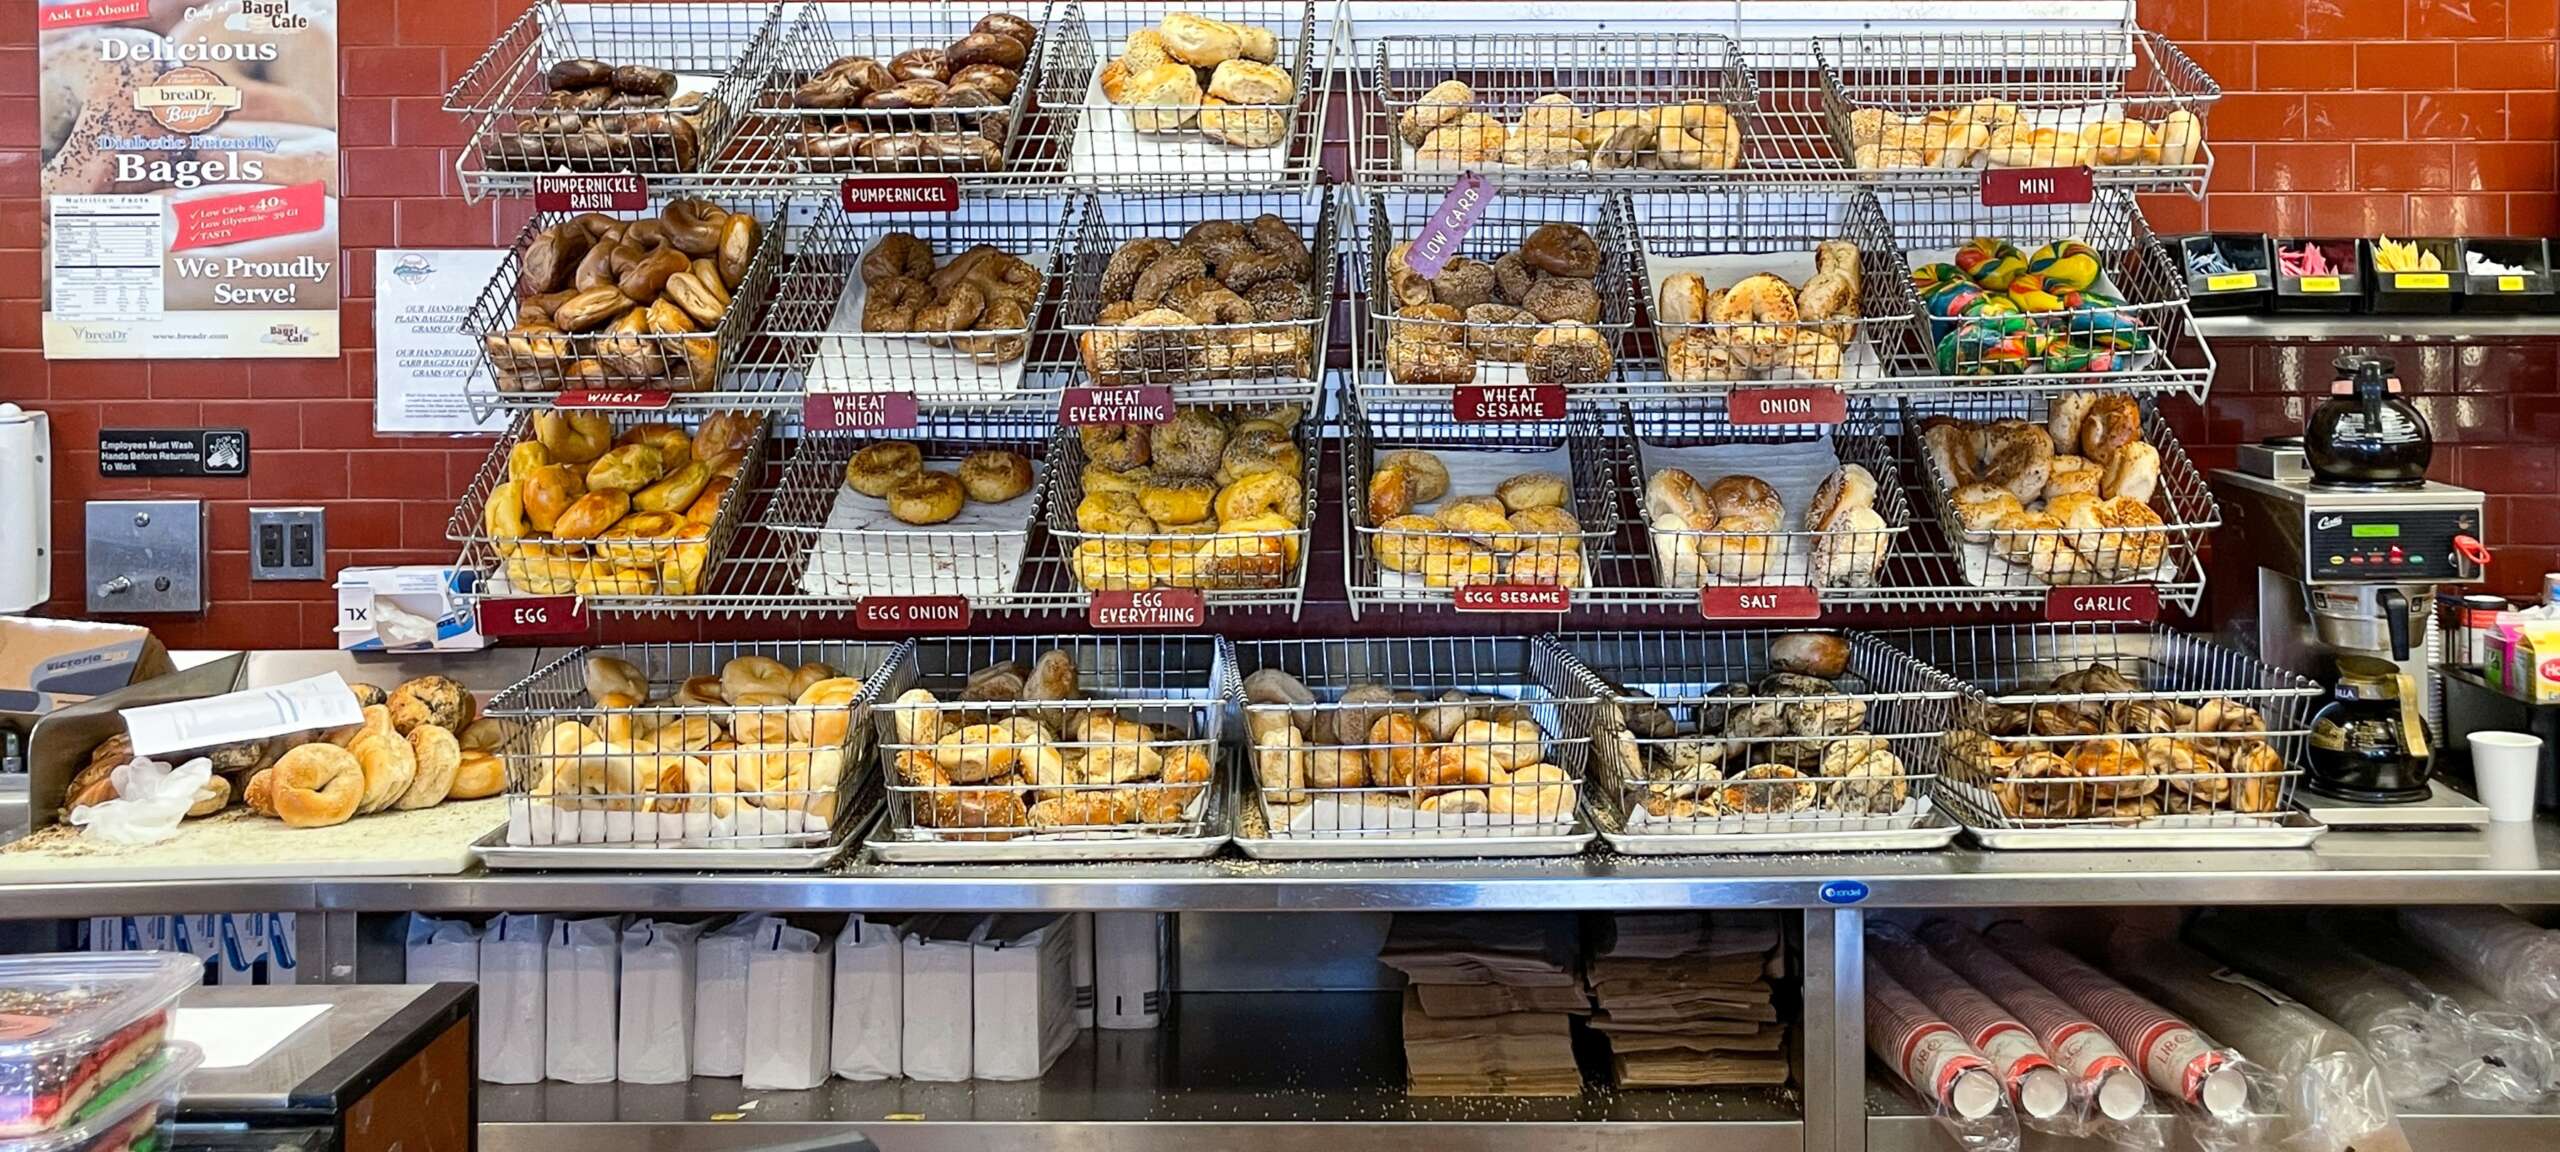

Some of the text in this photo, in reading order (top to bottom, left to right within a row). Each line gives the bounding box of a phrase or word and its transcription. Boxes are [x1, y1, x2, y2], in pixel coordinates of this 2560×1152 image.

[48, 2, 140, 21] Ask Us About!
[184, 4, 213, 22] Only
[242, 0, 289, 17] Bagel
[272, 14, 307, 28] Cafe
[99, 36, 278, 61] Delicious
[161, 89, 216, 100] breaDr.
[166, 101, 214, 122] Bagel
[97, 134, 280, 152] Diabetic Friendly
[115, 151, 264, 189] Bagels
[543, 177, 638, 193] PUMPERNICKLE
[2019, 178, 2055, 194] MINI
[571, 193, 613, 208] RAISIN
[851, 187, 947, 203] PUMPERNICKEL
[200, 209, 219, 218] Low
[222, 204, 246, 216] Carb
[200, 220, 220, 229] Low
[1421, 188, 1479, 261] LOW CARB
[200, 229, 231, 240] TASTY
[173, 255, 331, 283] We Proudly
[214, 283, 296, 304] Serve!
[422, 315, 454, 323] BAGELS
[152, 332, 229, 340] www.breadr.com
[270, 326, 298, 336] Bagel
[412, 325, 441, 333] GRAMS
[287, 334, 309, 342] Cafe
[395, 349, 414, 357] OUR
[422, 359, 454, 367] BAGELS
[412, 369, 441, 377] GRAMS
[587, 393, 643, 404] WHEAT
[832, 394, 886, 411] WHEAT
[1091, 390, 1140, 405] WHEAT
[1483, 388, 1536, 403] WHEAT
[1069, 405, 1164, 422] EVERYTHING
[1476, 402, 1544, 418] SESAME
[1760, 399, 1811, 414] ONION
[835, 411, 885, 426] ONION
[101, 441, 193, 451] Employees Must Wash
[101, 452, 200, 462] Hands Before Returning
[102, 462, 136, 471] To Work
[1132, 593, 1162, 607] EGG
[1464, 591, 1560, 603] EGG SESAME
[1740, 594, 1778, 609] SALT
[2073, 596, 2132, 612] GARLIC
[345, 608, 367, 621] XL
[514, 608, 547, 624] EGG
[867, 606, 959, 620] EGG ONION
[1099, 607, 1194, 623] EVERYTHING
[47, 654, 102, 670] Victoria
